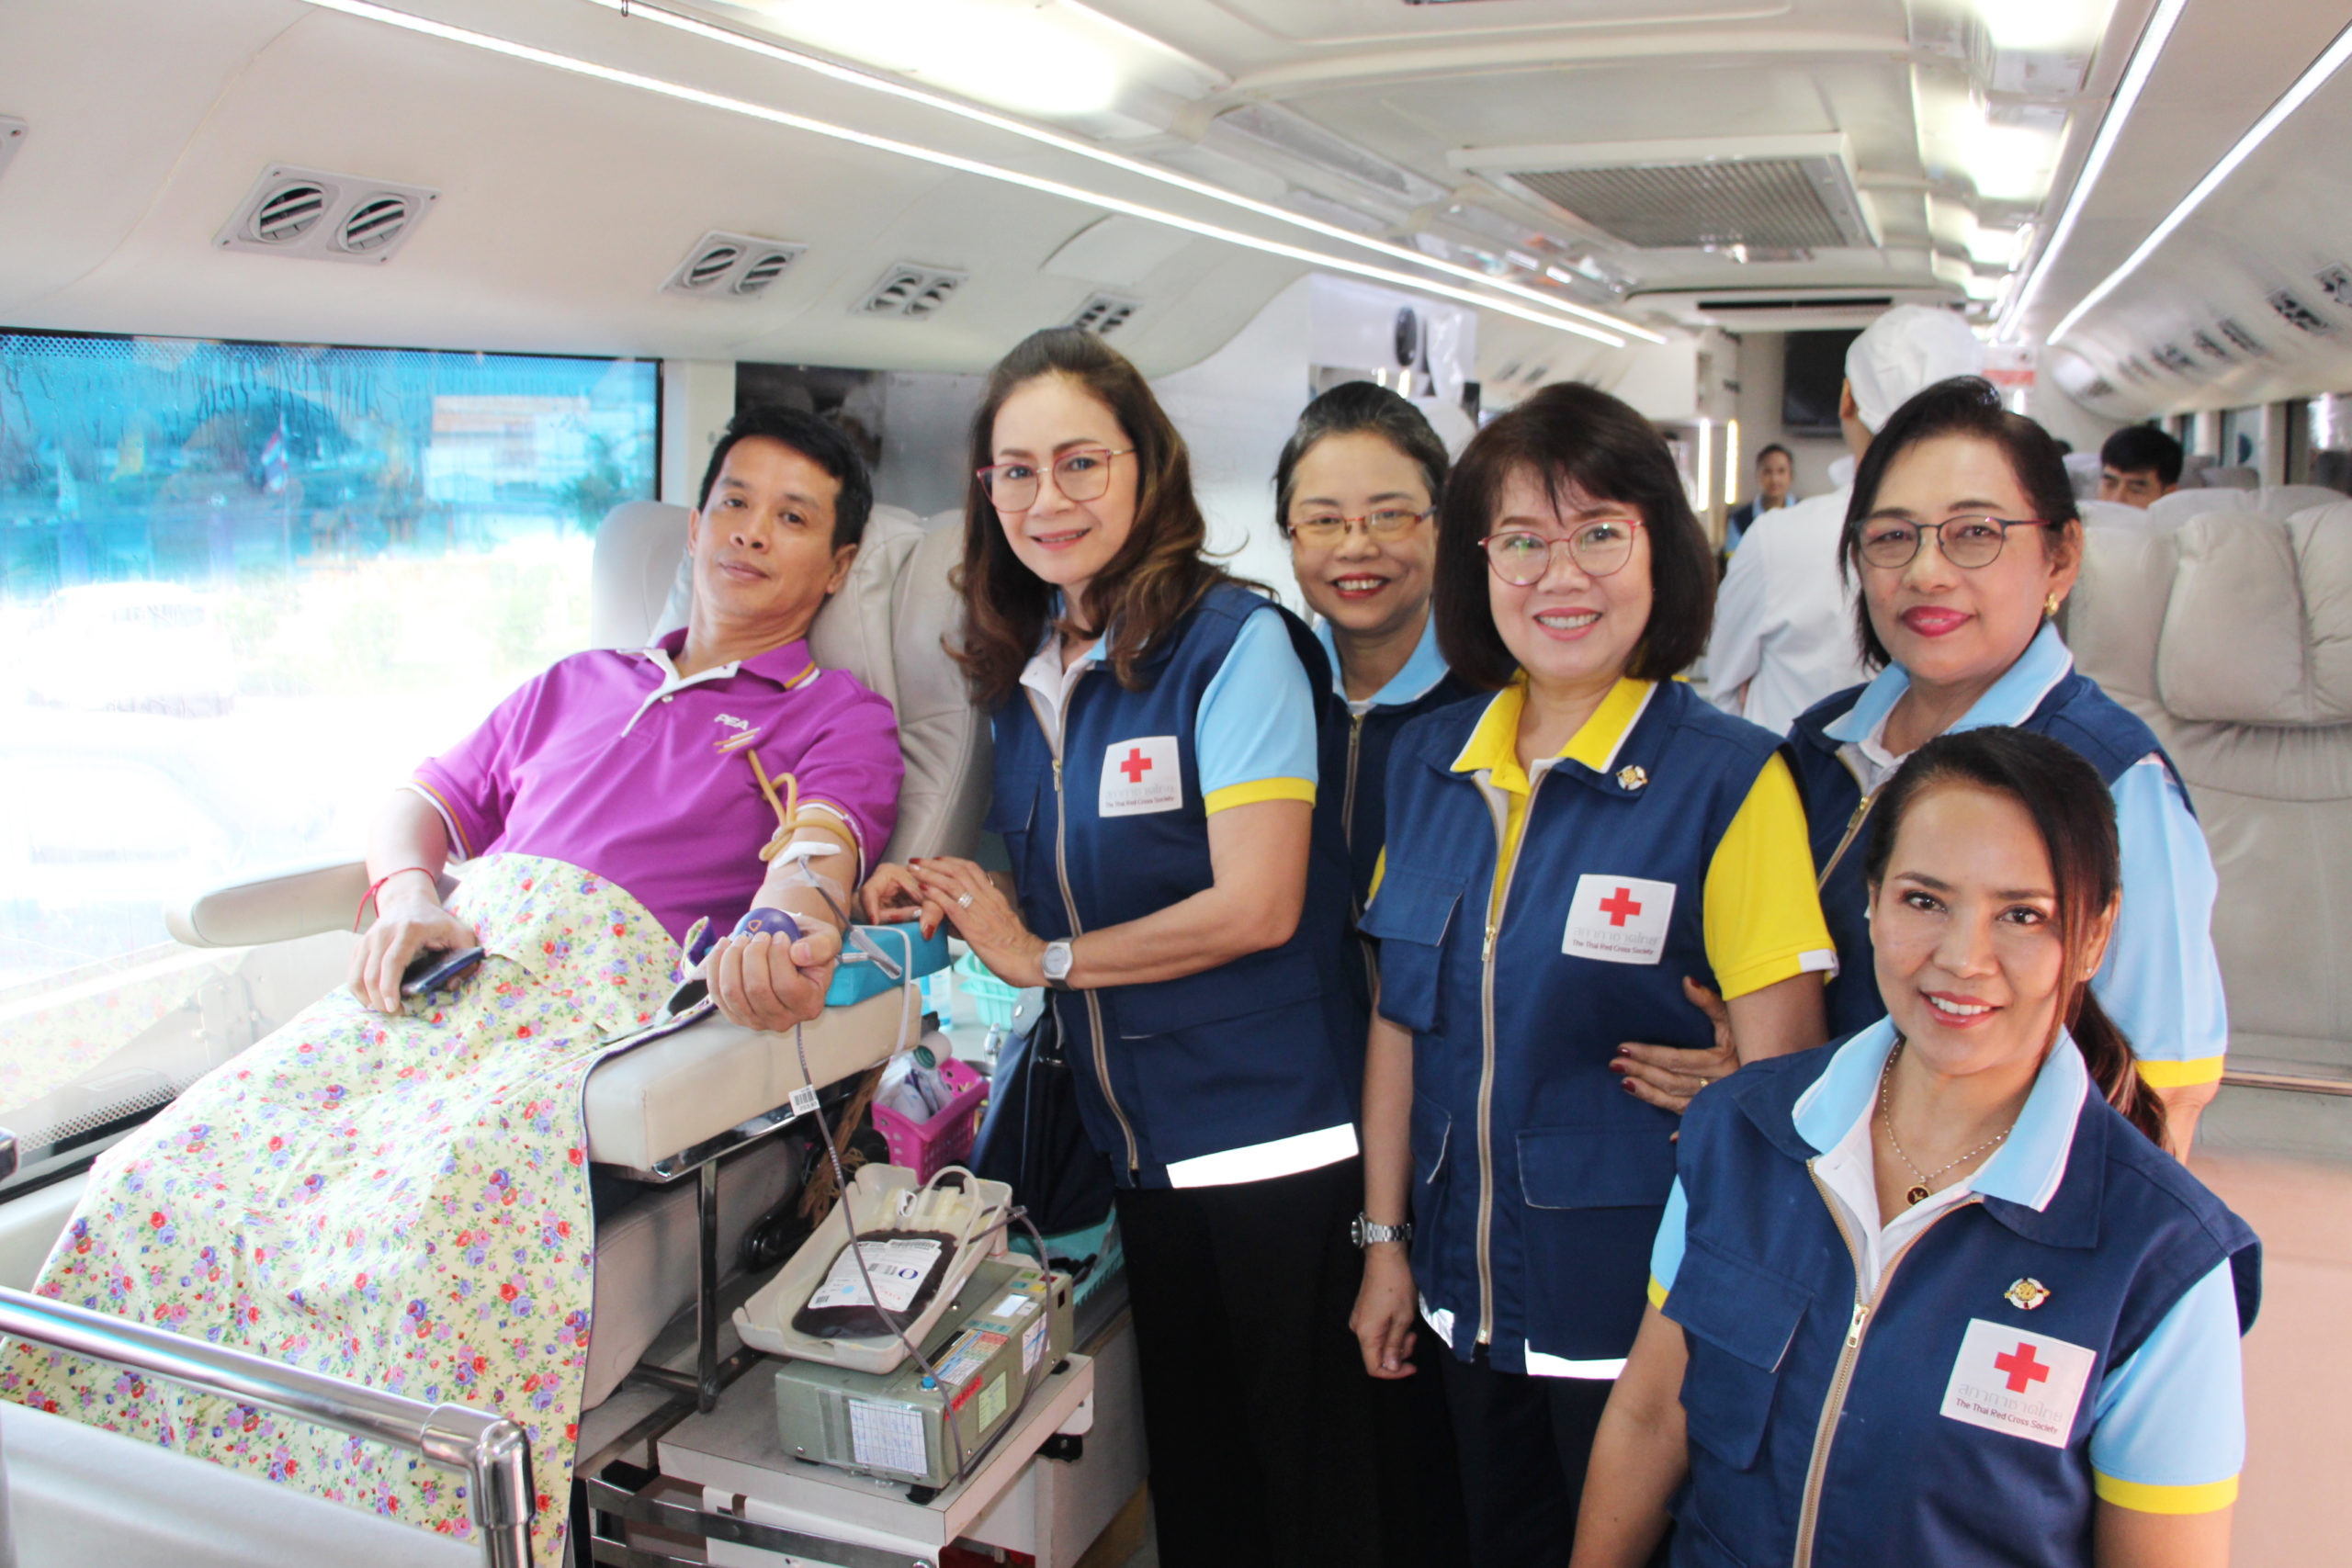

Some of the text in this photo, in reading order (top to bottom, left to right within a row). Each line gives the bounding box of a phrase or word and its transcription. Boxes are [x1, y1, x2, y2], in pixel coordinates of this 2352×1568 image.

[714, 713, 750, 731] PEA
[1586, 941, 1598, 949] Thai
[1600, 942, 1612, 951] Red
[1632, 947, 1654, 955] Society
[899, 1268, 919, 1280] O
[1956, 1398, 2058, 1434] The Thai Red Cross Society
